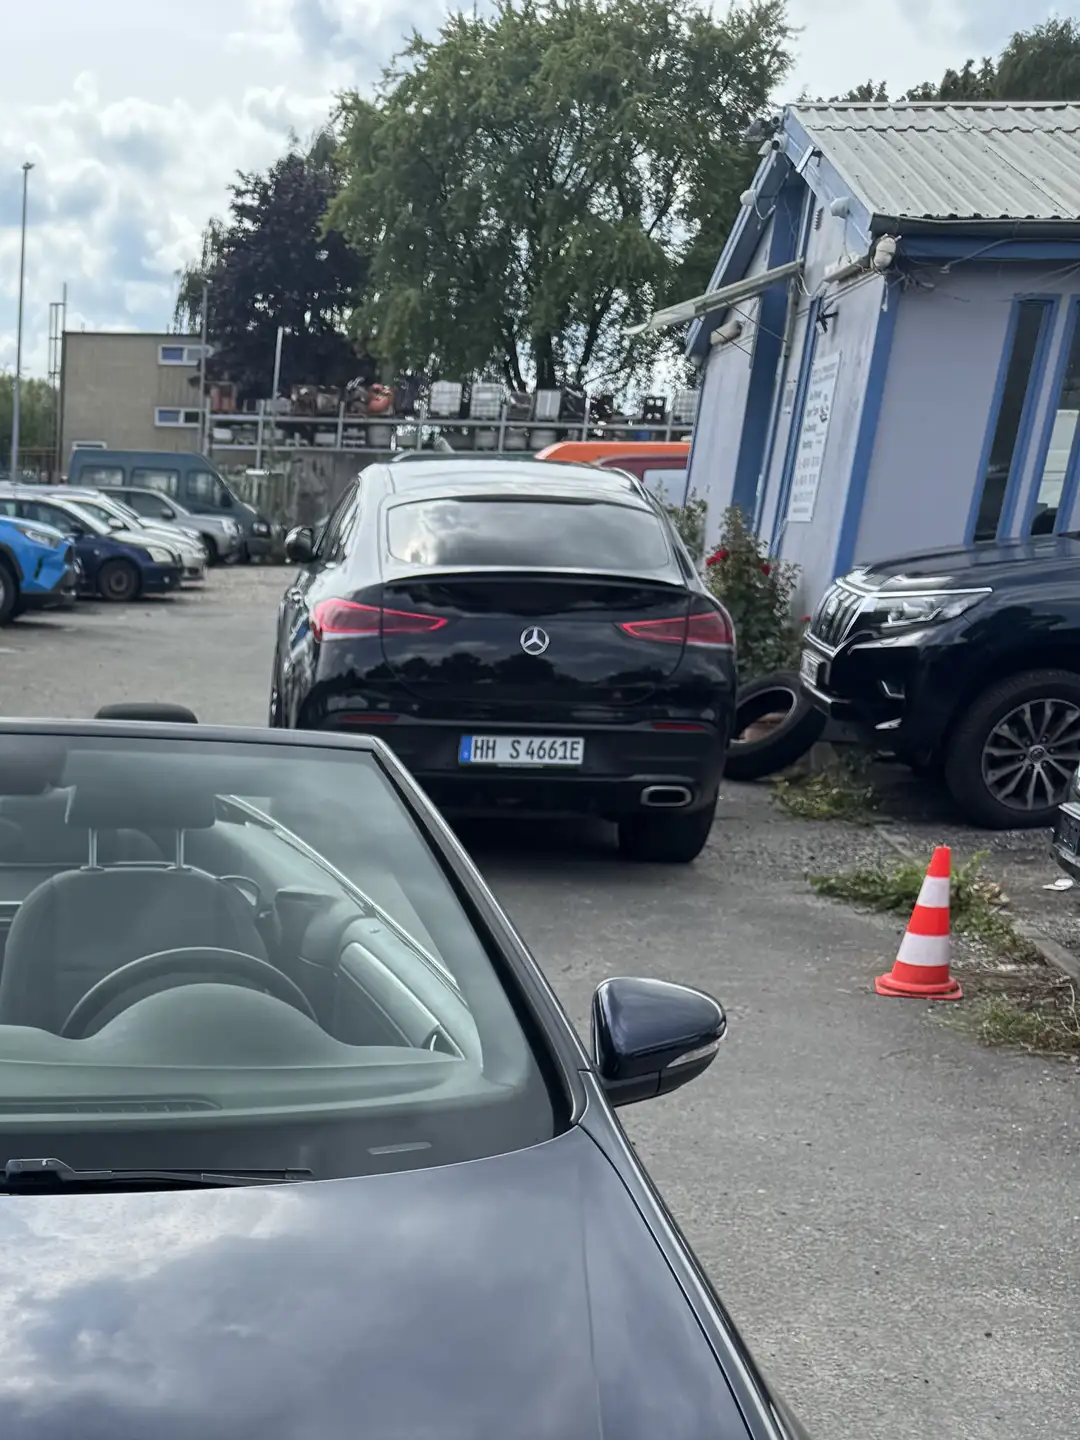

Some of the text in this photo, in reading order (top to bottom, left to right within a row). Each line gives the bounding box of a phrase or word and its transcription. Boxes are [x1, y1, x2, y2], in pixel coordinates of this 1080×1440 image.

[473, 739, 580, 761] HH S 4661E
